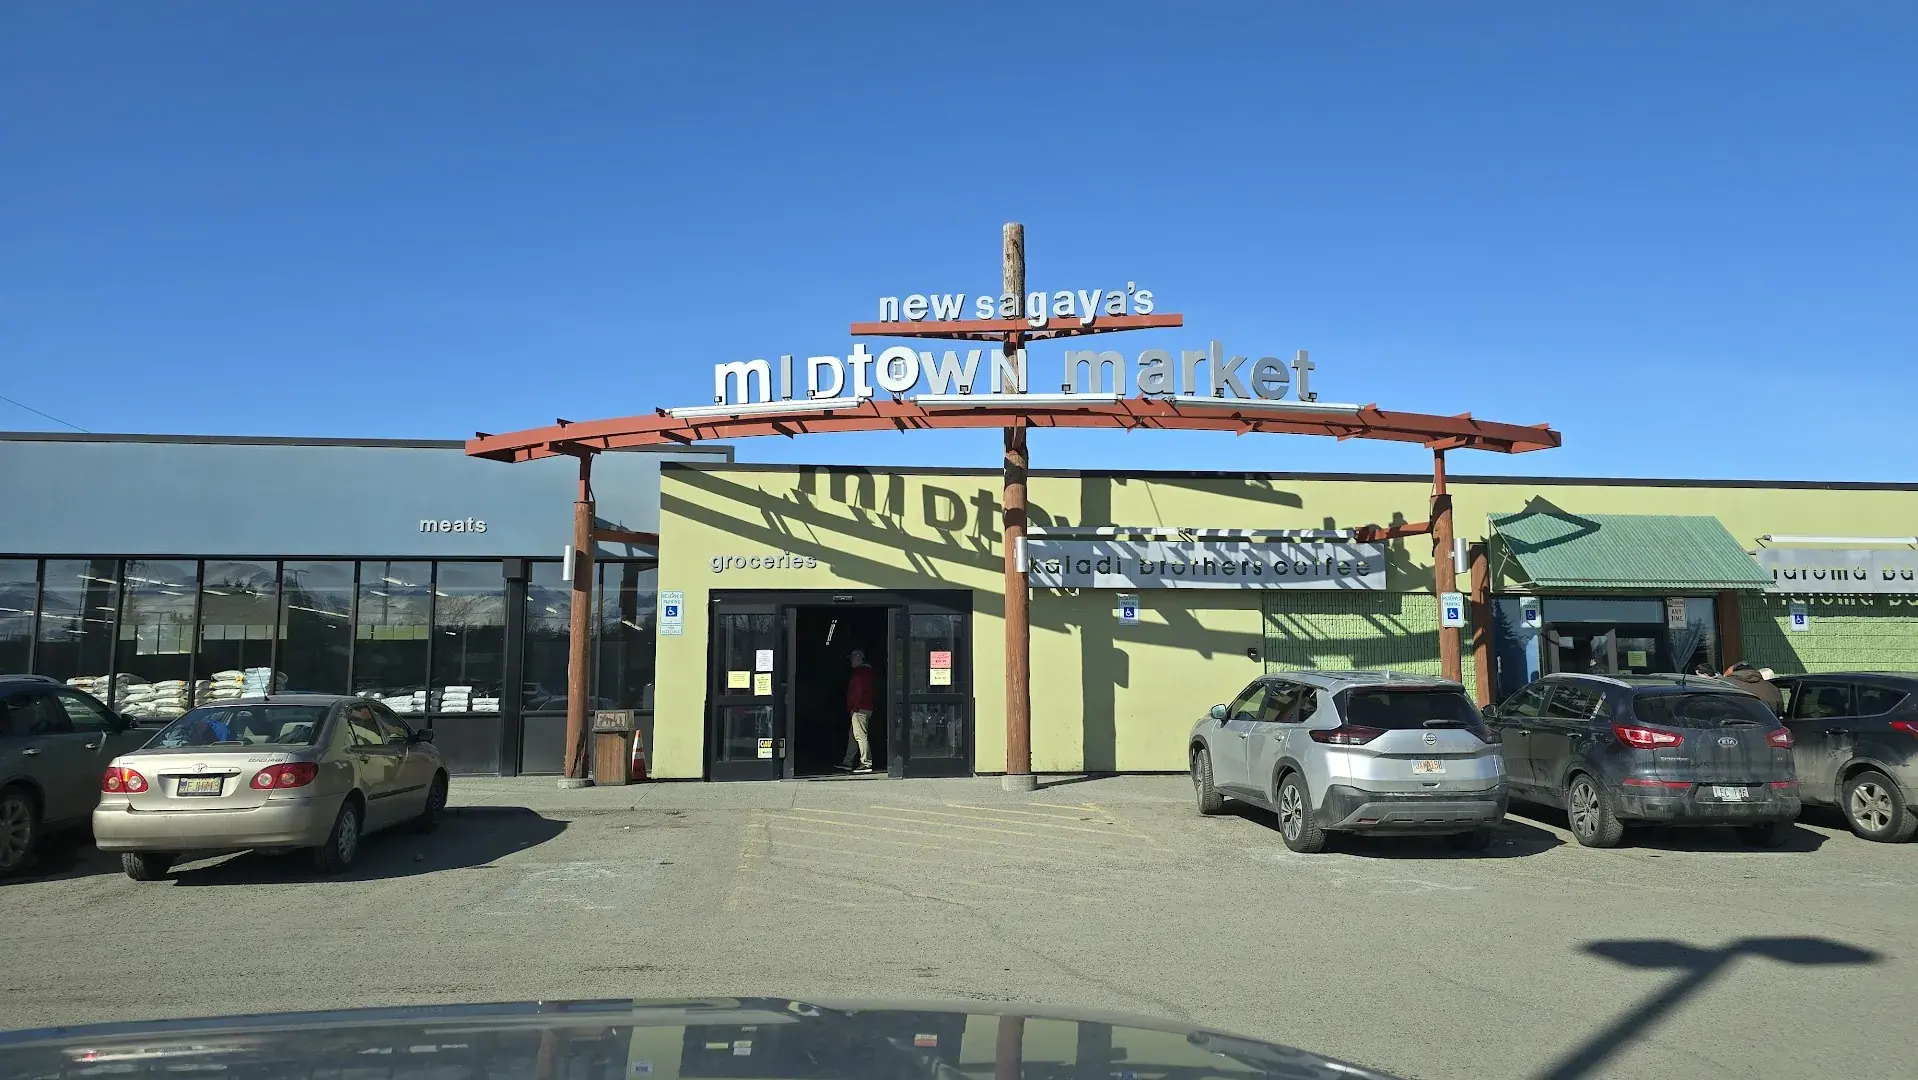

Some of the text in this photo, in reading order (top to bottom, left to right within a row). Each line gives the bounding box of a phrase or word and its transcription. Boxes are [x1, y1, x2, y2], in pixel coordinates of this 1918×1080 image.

[879, 281, 1154, 329] new sagaya's
[1062, 340, 1317, 402] market
[419, 516, 488, 533] meats
[709, 550, 817, 573] groceries
[1029, 555, 1371, 577] kaladi brothers coffee
